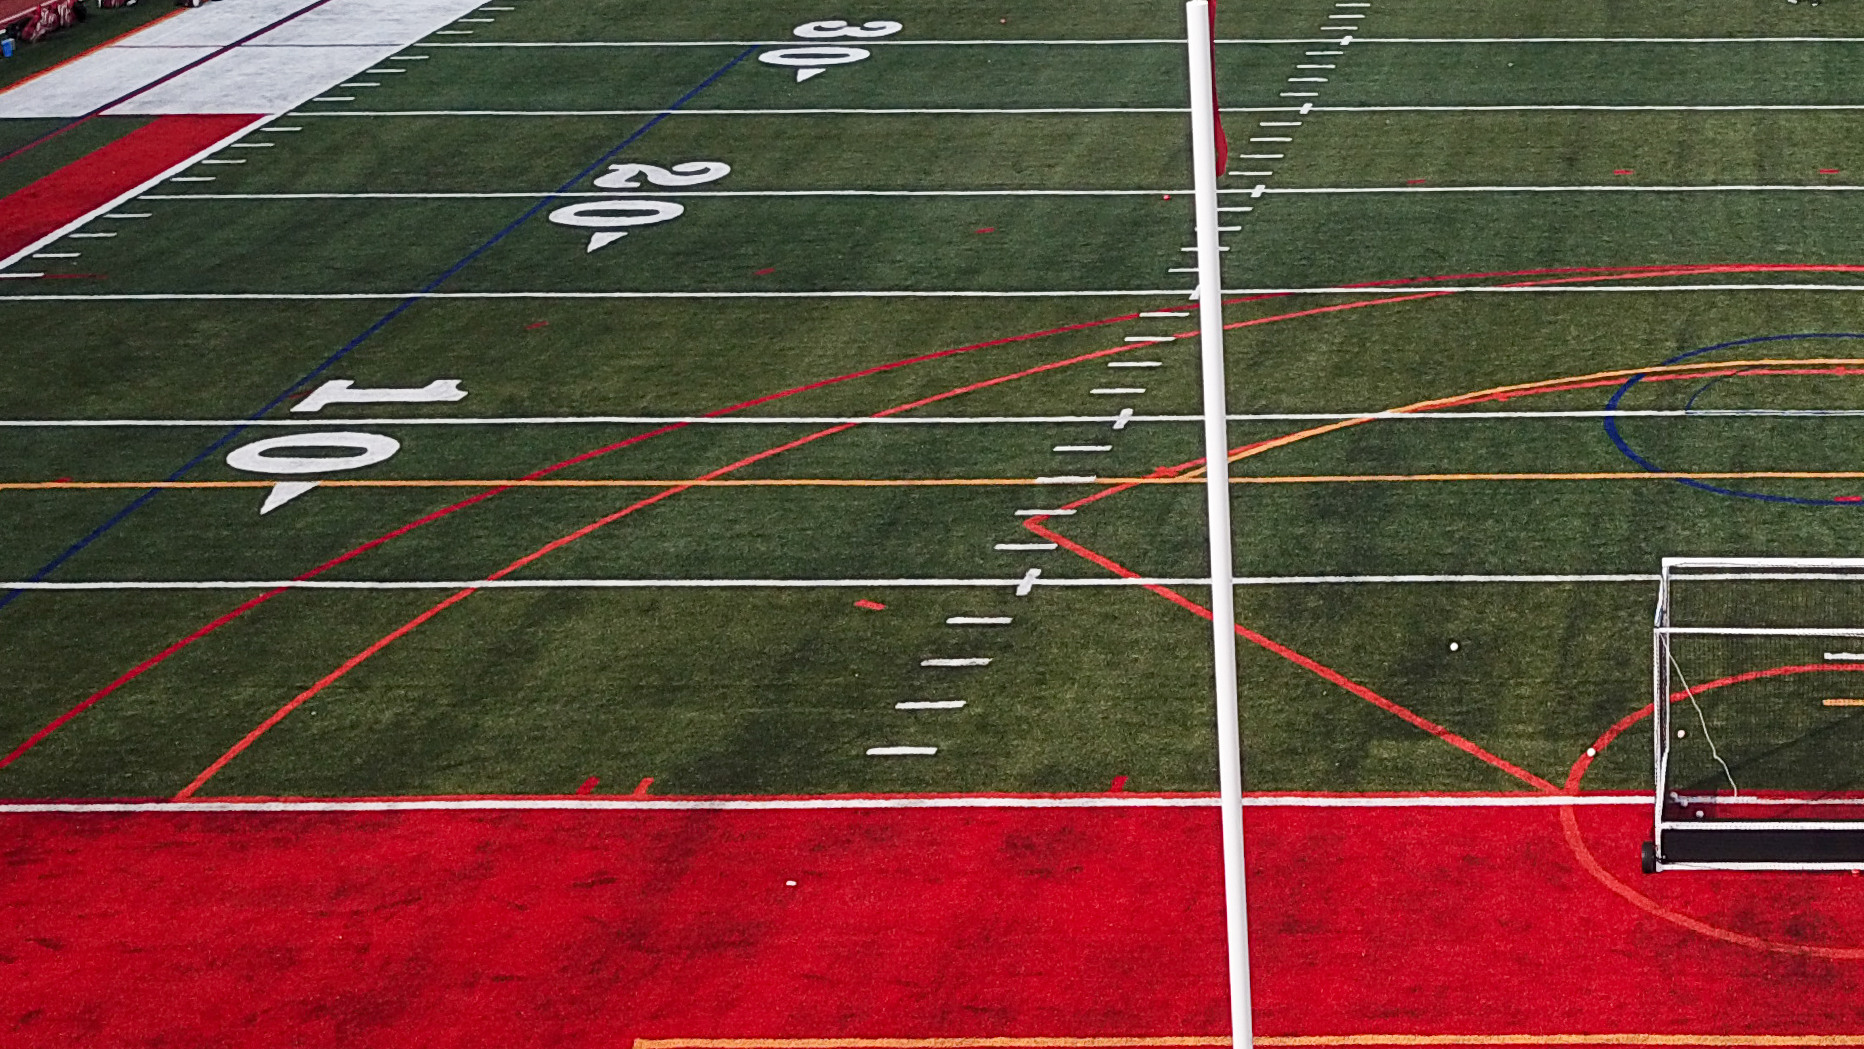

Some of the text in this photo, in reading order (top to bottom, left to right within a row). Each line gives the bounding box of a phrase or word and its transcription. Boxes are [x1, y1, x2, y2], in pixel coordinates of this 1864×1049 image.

[758, 19, 903, 68] 30
[548, 161, 731, 228] 20
[226, 379, 469, 475] 10
